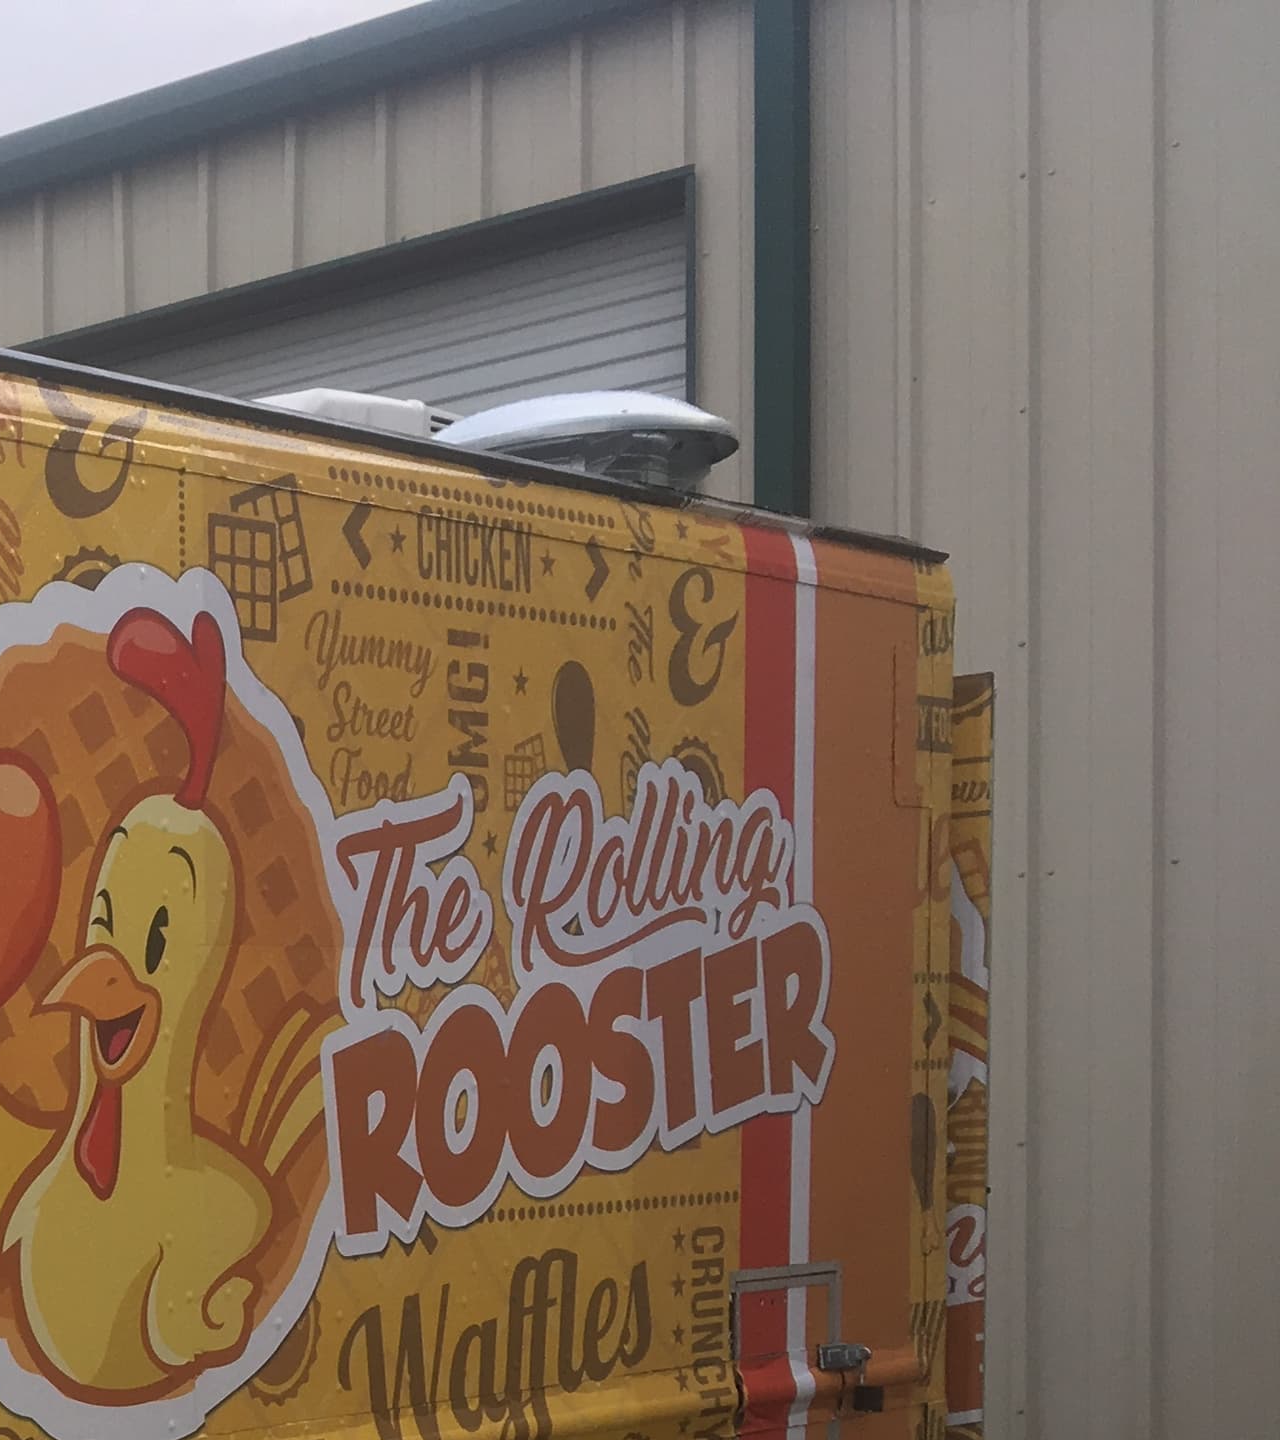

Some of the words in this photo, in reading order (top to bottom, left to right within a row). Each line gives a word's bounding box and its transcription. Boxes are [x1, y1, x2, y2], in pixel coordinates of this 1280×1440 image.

[416, 505, 532, 593] CHICKEN
[304, 608, 436, 698] Yummy
[326, 681, 418, 743] Street
[330, 747, 416, 806] Food
[336, 802, 485, 1009] The
[513, 776, 792, 968] Rolling
[332, 920, 831, 1237] ROOSTER
